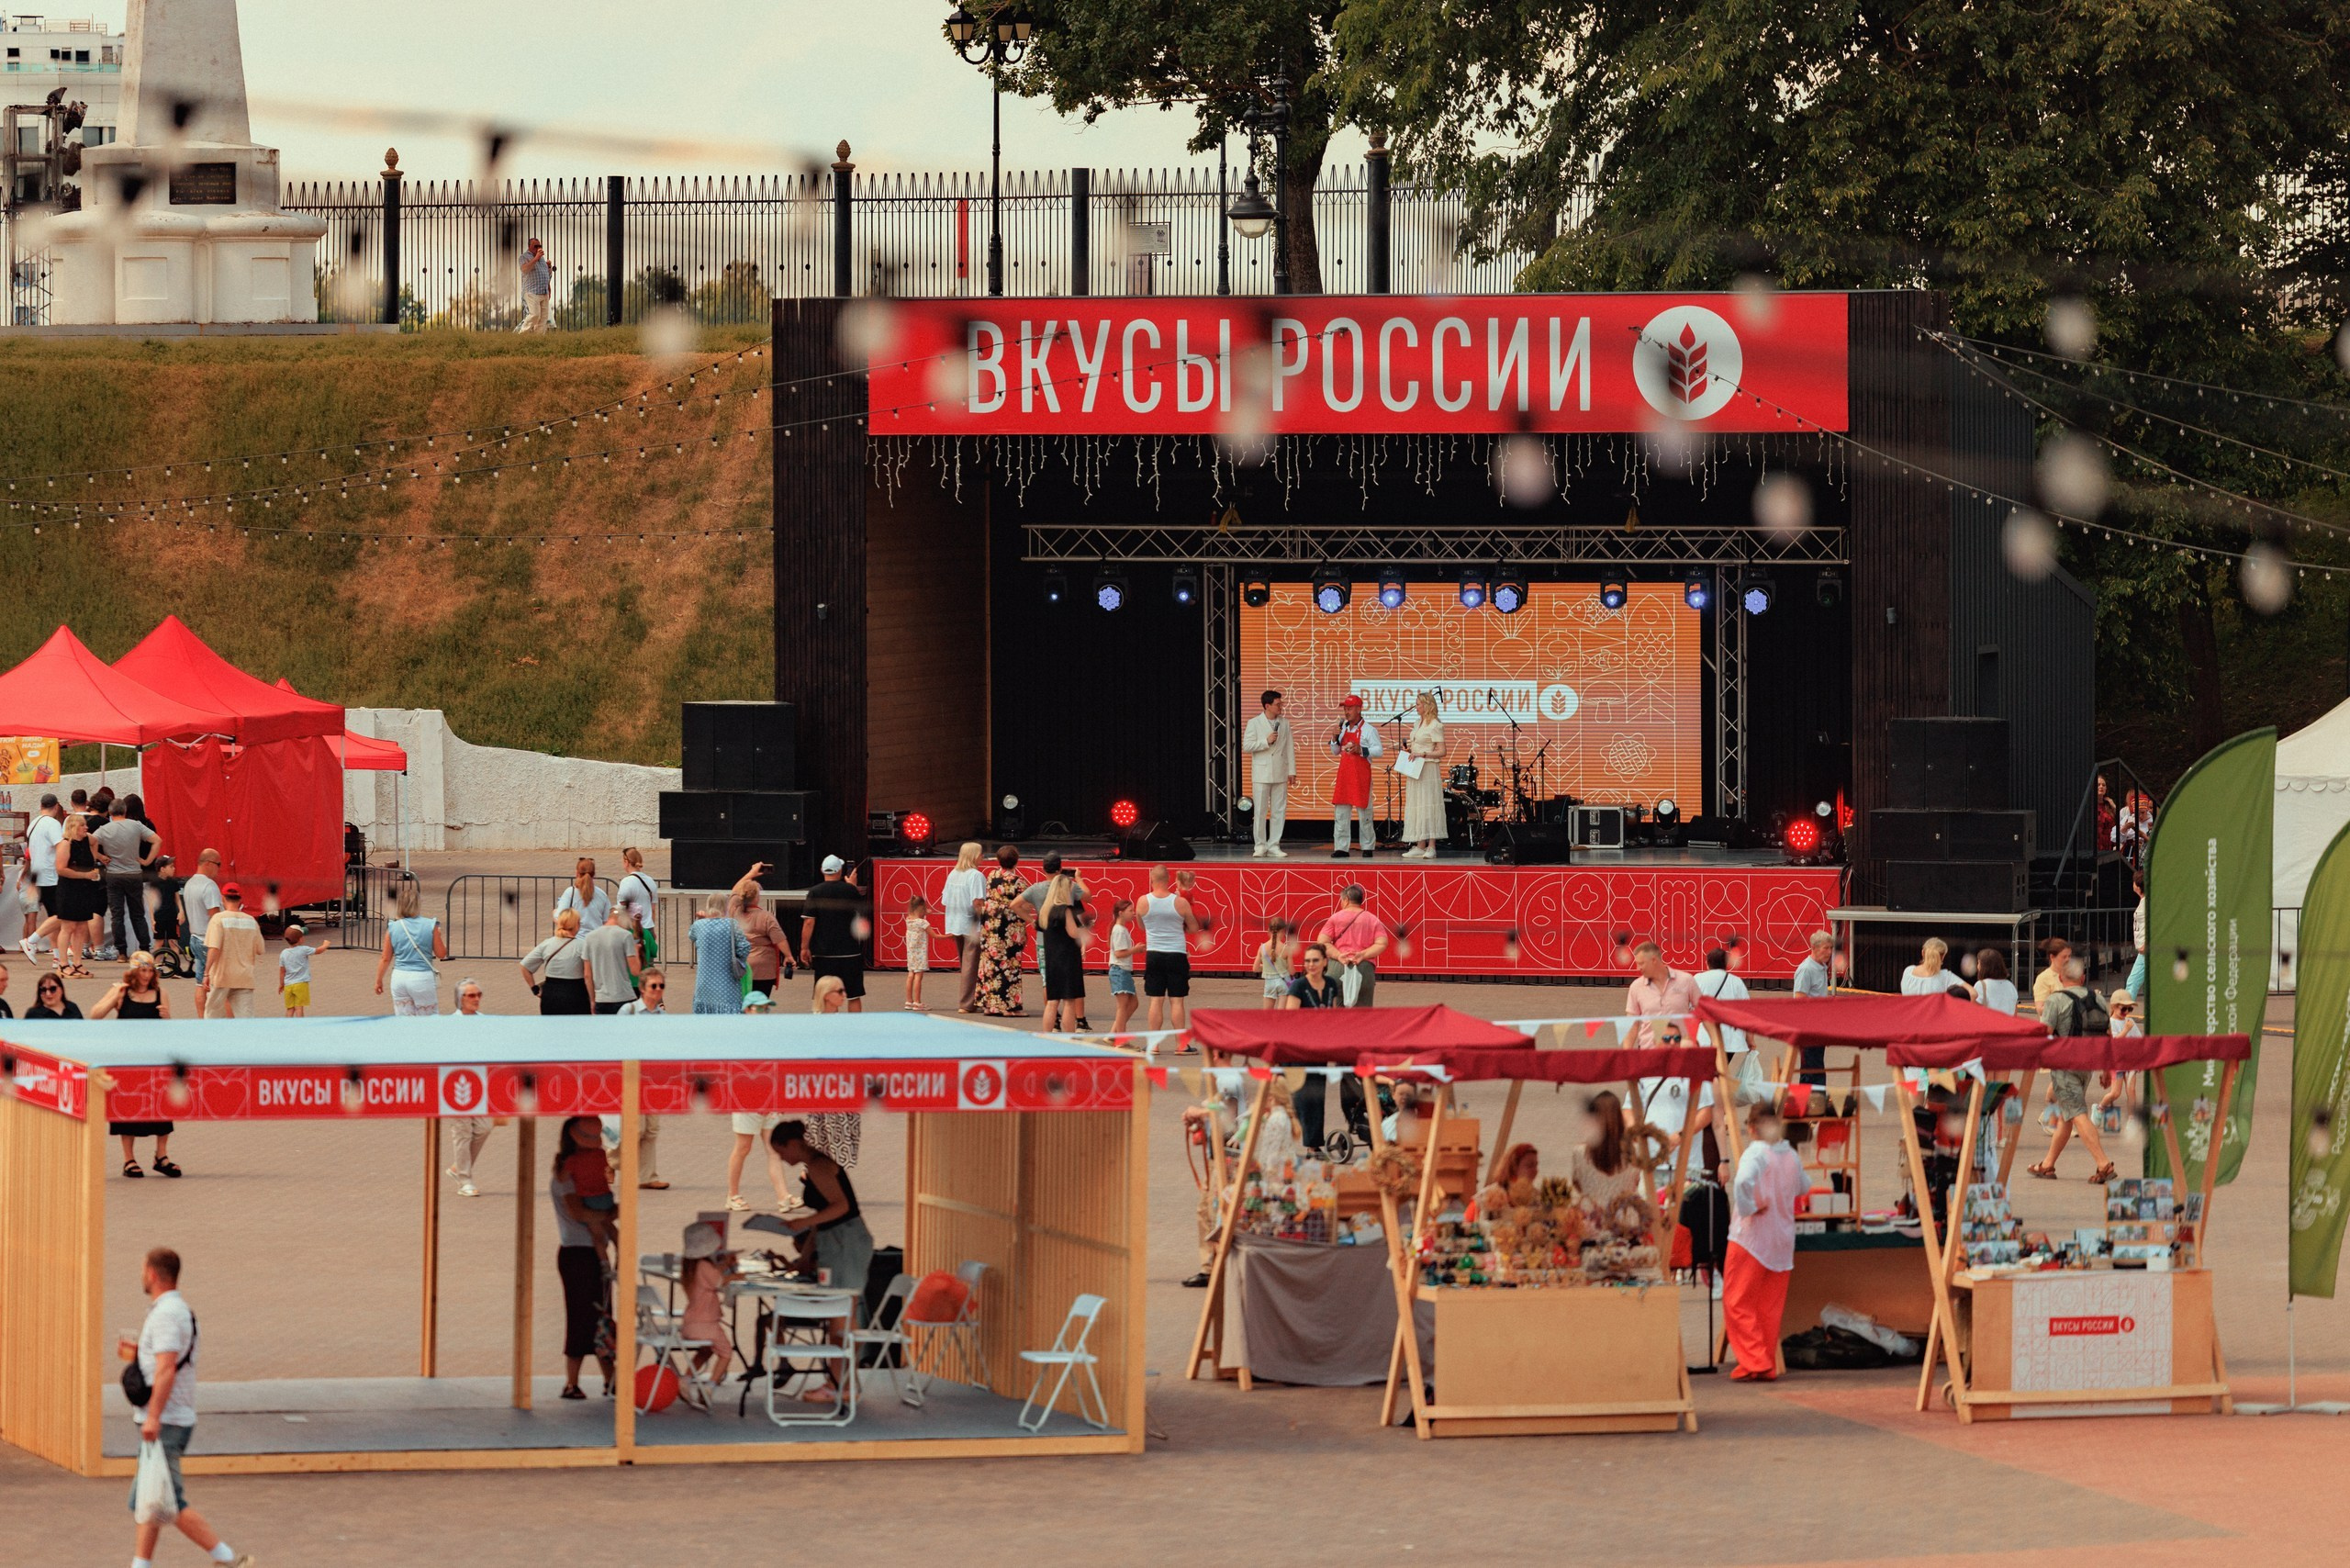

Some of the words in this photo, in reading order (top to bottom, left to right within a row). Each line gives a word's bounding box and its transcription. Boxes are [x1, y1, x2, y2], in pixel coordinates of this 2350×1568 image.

[968, 319, 1230, 413] ВКУСЫ
[1271, 317, 1590, 412] РОССИИ
[1360, 689, 1432, 711] ВКУС
[1442, 689, 1529, 711] РОССИИ
[2205, 838, 2217, 907] хозяйства
[2206, 911, 2217, 982] сельского
[2225, 918, 2240, 1000] Федерации
[258, 1078, 331, 1105] ВКУСЫ
[340, 1077, 425, 1104] РОССИИ
[785, 1073, 855, 1100] ВКУСЫ
[863, 1072, 946, 1099] РОССИИ
[2052, 1320, 2080, 1333] ВКУСЫ
[2081, 1318, 2115, 1331] РОССИИ
